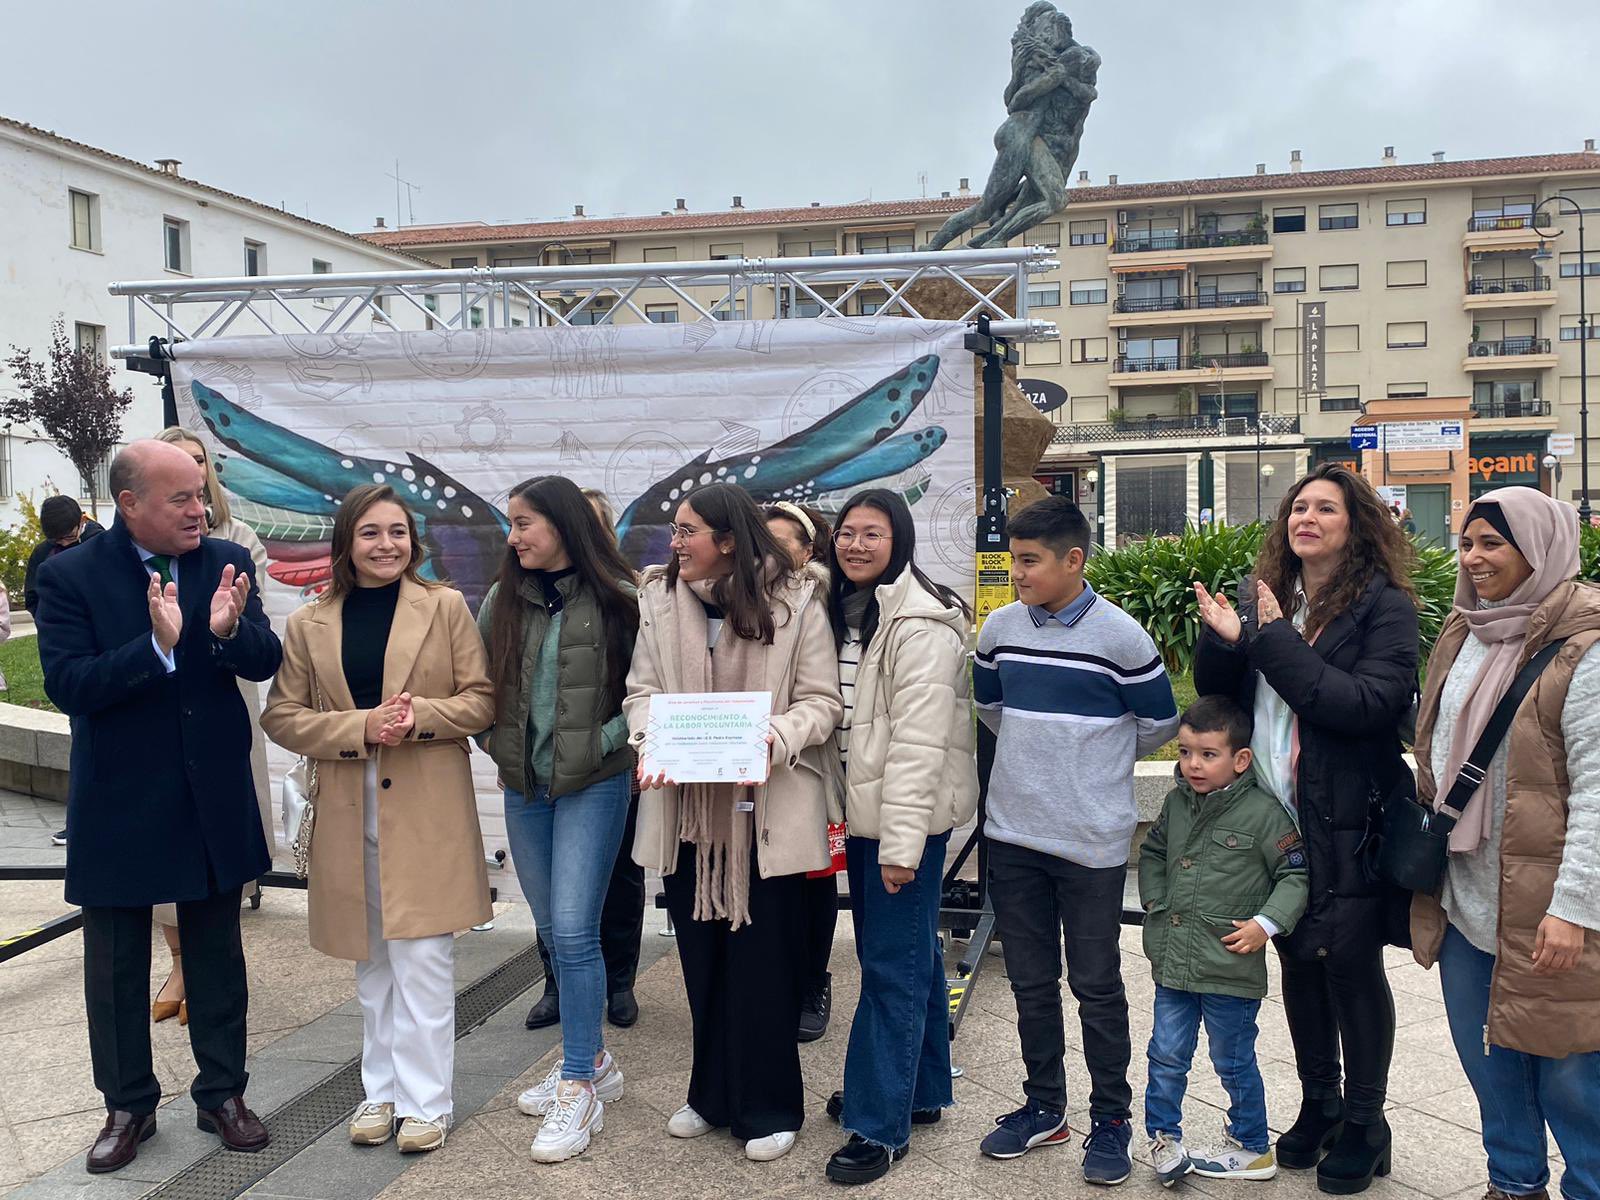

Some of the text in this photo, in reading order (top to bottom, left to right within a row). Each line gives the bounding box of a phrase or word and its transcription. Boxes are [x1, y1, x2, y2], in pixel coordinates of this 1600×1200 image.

[1311, 322, 1318, 340] LA
[1025, 392, 1047, 403] AZA
[1468, 452, 1536, 481] açant
[704, 721, 752, 729] VOLUNTARIA
